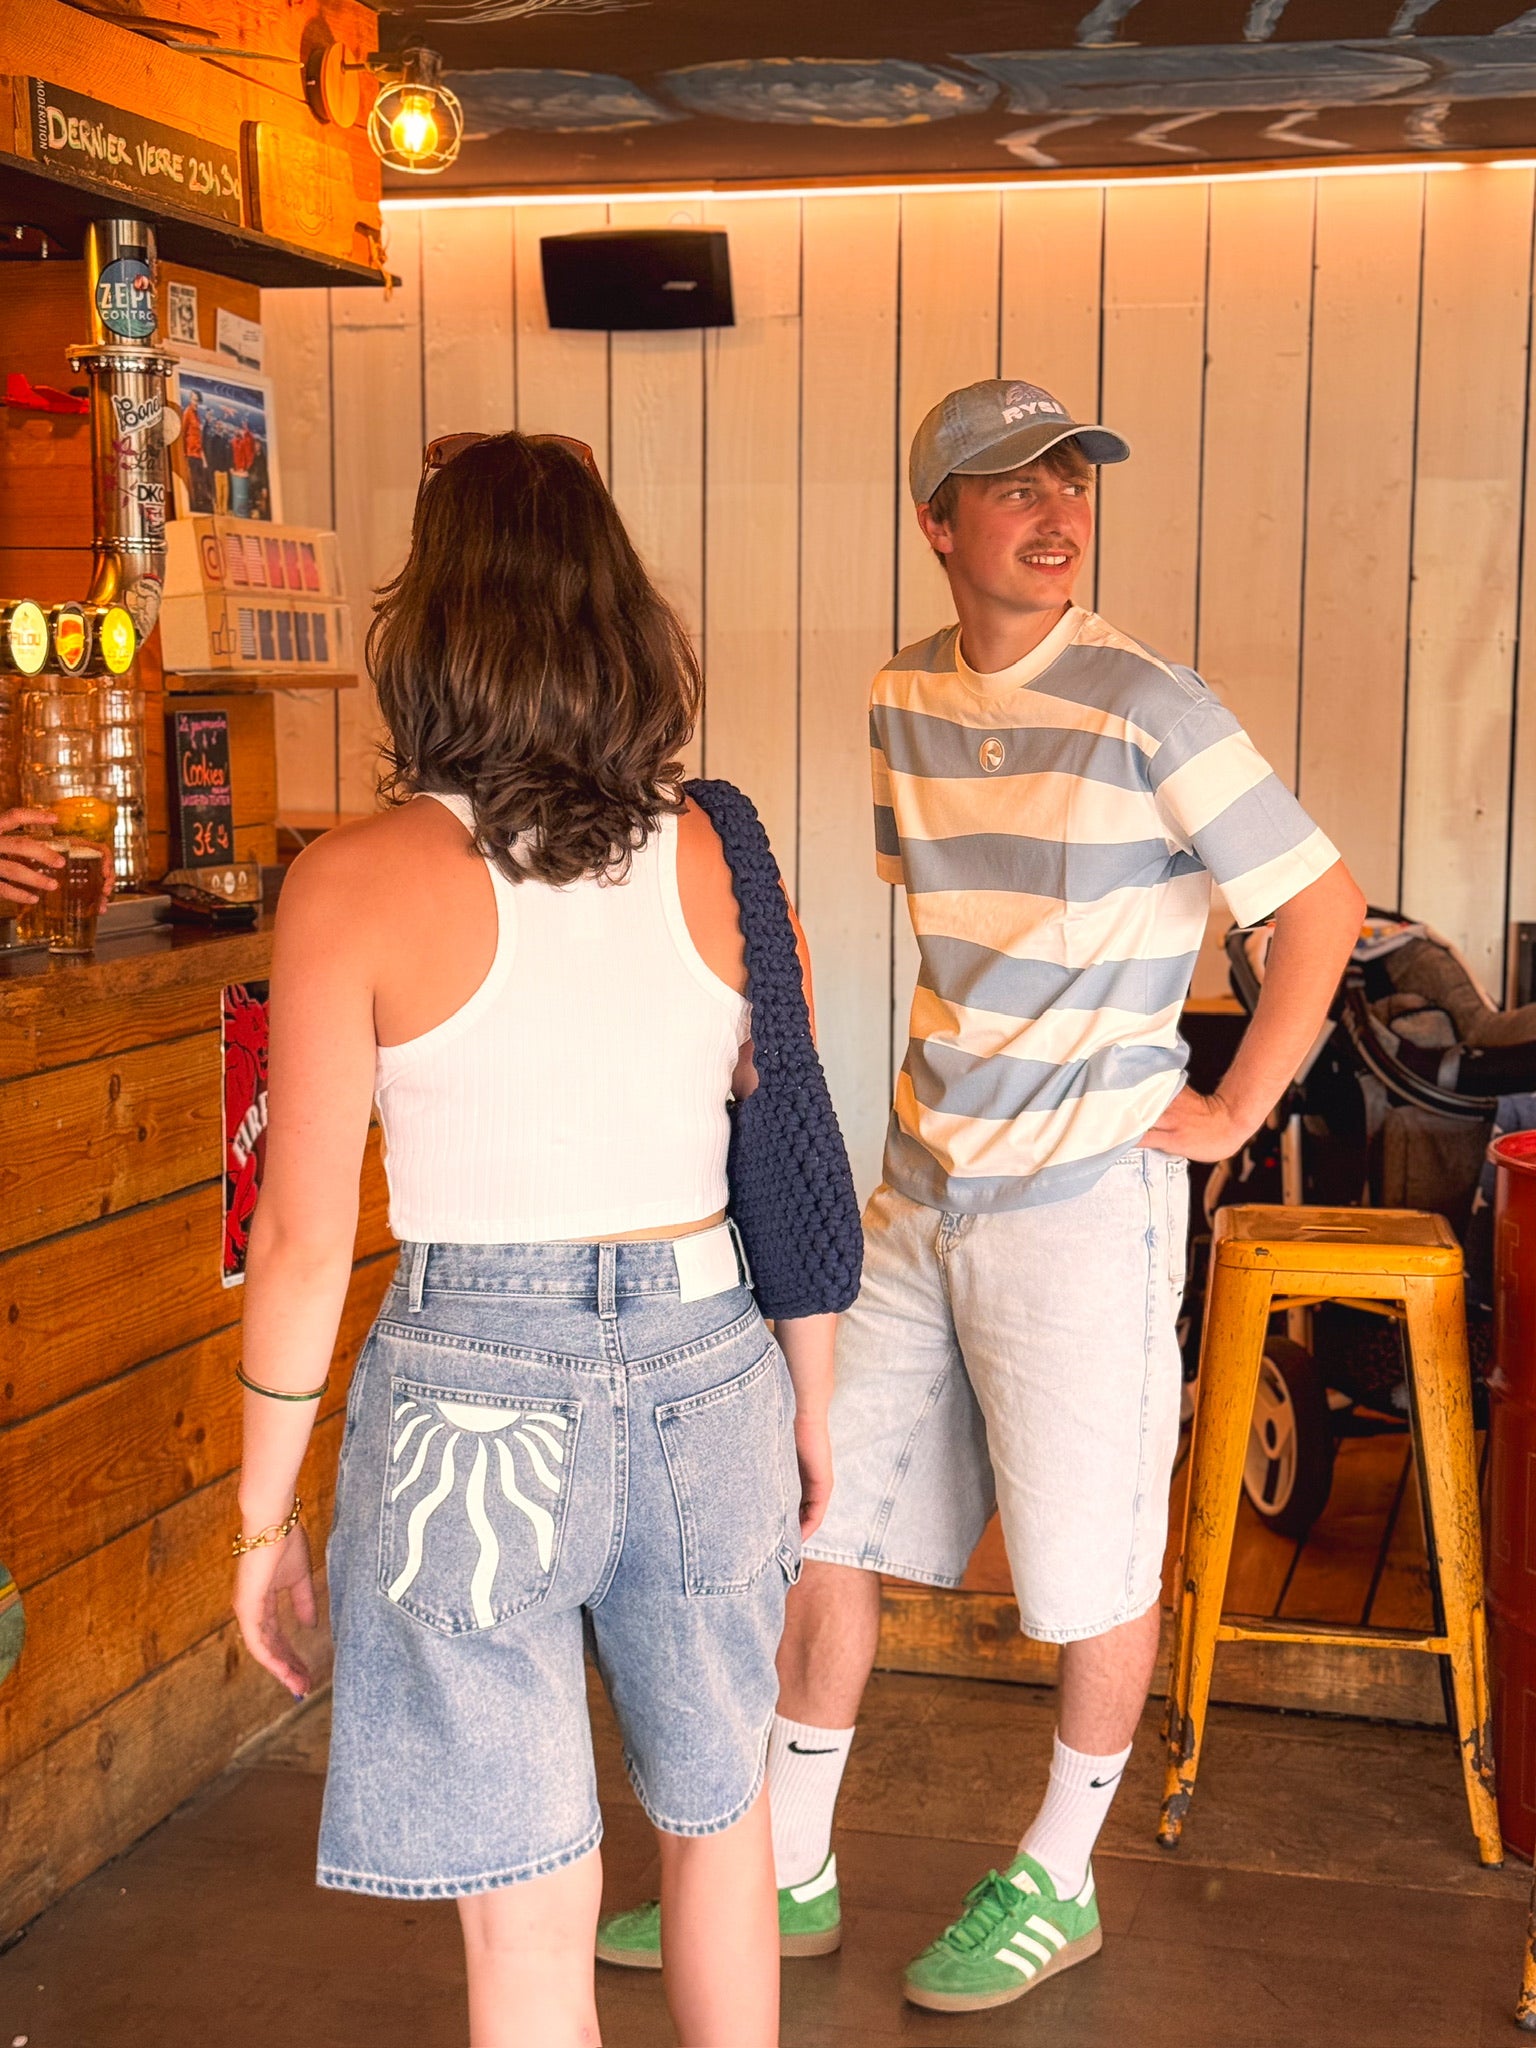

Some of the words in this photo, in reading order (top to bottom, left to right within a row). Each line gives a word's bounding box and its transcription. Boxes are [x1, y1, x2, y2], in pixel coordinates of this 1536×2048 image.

[46, 106, 134, 166] DERNIER
[135, 140, 184, 184] VERRE
[183, 751, 225, 787] Cookies
[193, 821, 216, 856] 3€
